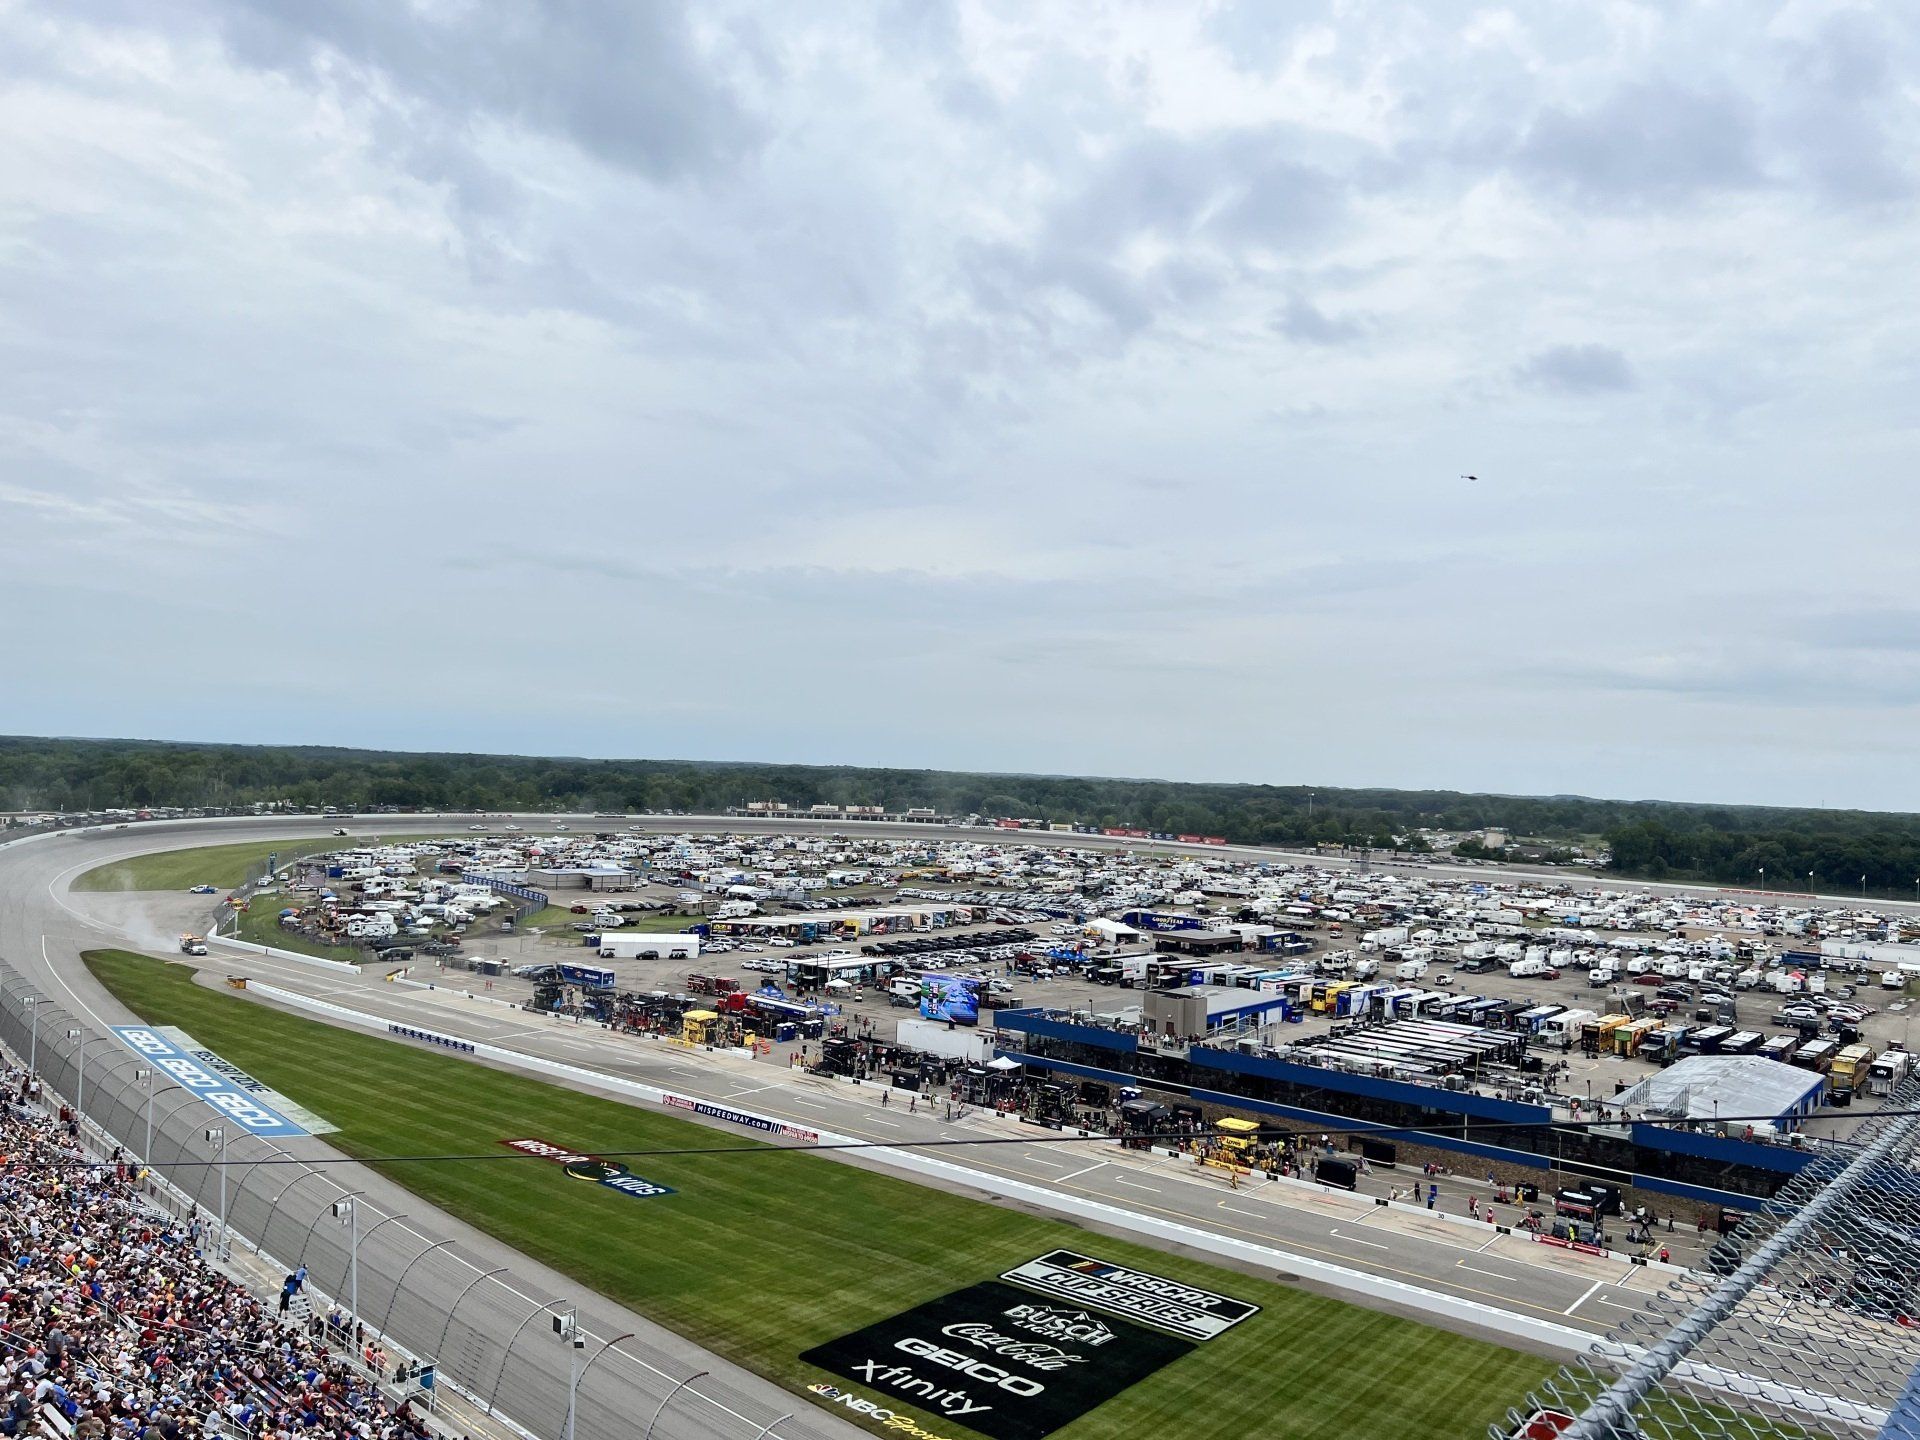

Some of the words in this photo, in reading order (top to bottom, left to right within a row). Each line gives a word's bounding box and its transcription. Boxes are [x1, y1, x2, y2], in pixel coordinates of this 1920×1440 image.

[120, 1030, 175, 1054] GEICO
[157, 1058, 222, 1087] GEICO
[190, 1051, 245, 1075] RESTART
[229, 1076, 272, 1092] ZONE
[204, 1092, 283, 1127] GEICO
[697, 1104, 768, 1129] MISPEEDWAY.com
[508, 1139, 590, 1163] NASCAR
[606, 1177, 666, 1195] KIDS
[1039, 1272, 1100, 1291] CUP
[1098, 1288, 1201, 1324] SERIES
[1101, 1271, 1223, 1308] NASCAR
[1001, 1304, 1118, 1347] BUSCH
[1012, 1320, 1075, 1342] LIGHT
[894, 1337, 1045, 1397] GEICO
[834, 1393, 895, 1421] NBC
